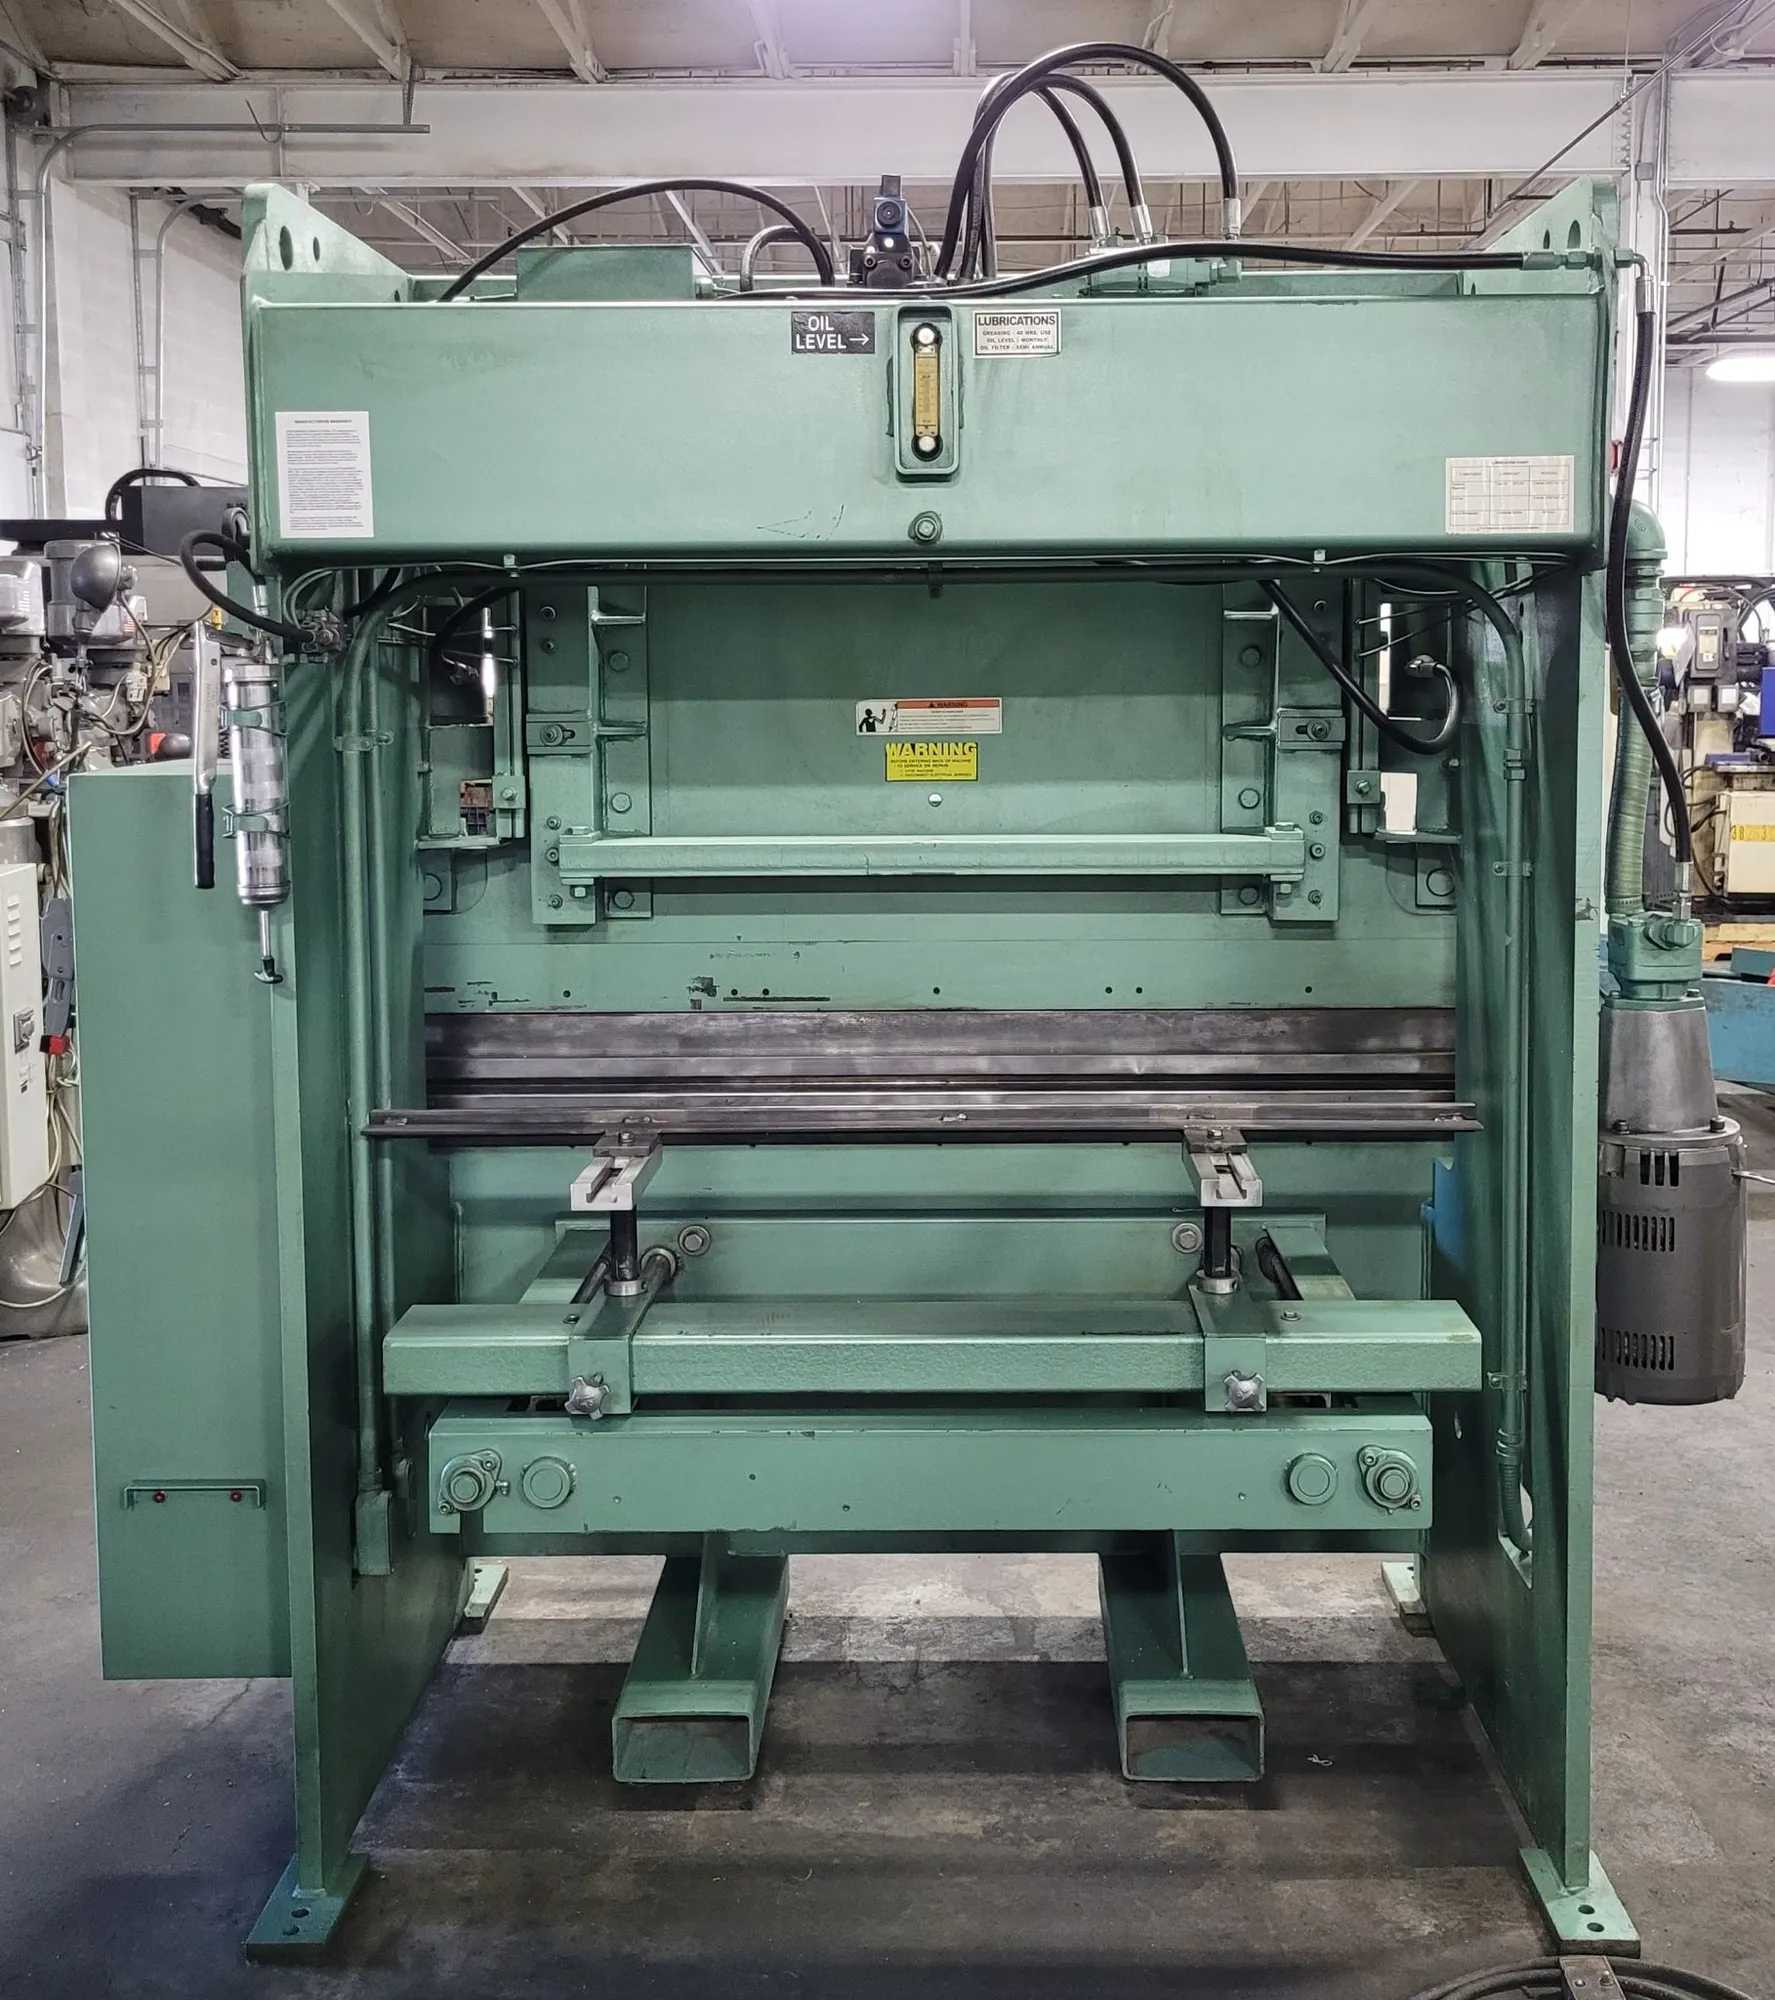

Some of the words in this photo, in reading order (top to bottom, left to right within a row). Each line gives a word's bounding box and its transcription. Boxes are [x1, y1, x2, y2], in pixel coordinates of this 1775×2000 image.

[808, 315, 834, 331] OIL
[978, 315, 1056, 326] LUBRICATIONS
[796, 333, 847, 349] LEVEL
[886, 742, 976, 756] WARNING
